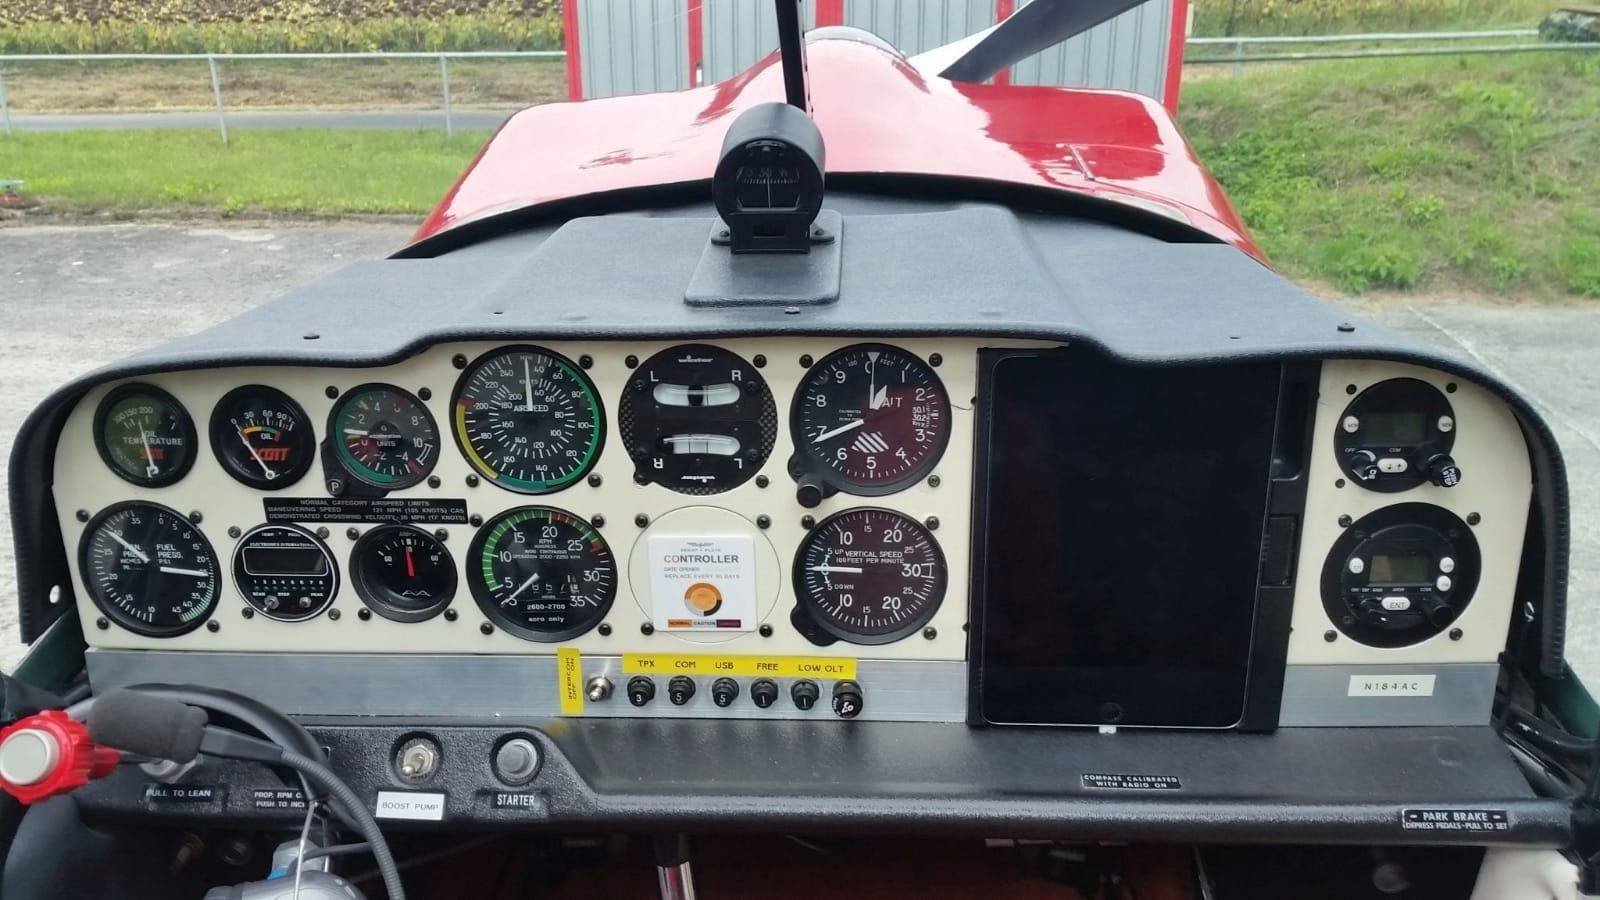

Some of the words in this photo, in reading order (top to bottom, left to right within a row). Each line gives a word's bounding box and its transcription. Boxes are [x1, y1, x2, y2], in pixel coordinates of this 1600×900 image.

[650, 371, 659, 382] L
[731, 370, 741, 381] R
[835, 371, 846, 384] 9
[916, 388, 925, 401] 2
[816, 394, 827, 407] 8
[243, 411, 254, 420] 30
[358, 414, 365, 424] 2
[412, 416, 418, 426] 8
[260, 432, 273, 440] OIL
[916, 429, 925, 442] 3
[413, 438, 423, 448] 10
[837, 448, 848, 460] 6
[895, 447, 907, 460] 4
[653, 458, 663, 469] R
[734, 458, 743, 469] L
[866, 457, 877, 469] 5
[331, 482, 339, 491] P
[542, 526, 558, 538] 20
[864, 525, 872, 533] 15
[513, 532, 525, 543] 15
[840, 532, 853, 545] 10
[883, 529, 902, 543] 20
[567, 540, 583, 551] 25
[904, 546, 914, 554] 25
[500, 551, 512, 562] 10
[664, 555, 739, 563] CONTROLLER
[583, 570, 600, 581] 30
[901, 563, 921, 577] 30
[505, 577, 513, 588] 5
[570, 596, 586, 607] 35
[840, 594, 853, 607] 10
[882, 597, 901, 610] 20
[638, 660, 655, 668] TPX
[715, 662, 734, 670] USB
[757, 663, 778, 671] FREE
[798, 664, 821, 672] LOW
[146, 789, 168, 797] PULL
[173, 789, 184, 797] TO
[188, 789, 211, 797] LEAN
[497, 794, 535, 806] STARTER
[1423, 812, 1448, 821] PARK
[1453, 812, 1488, 821] BRAKE
